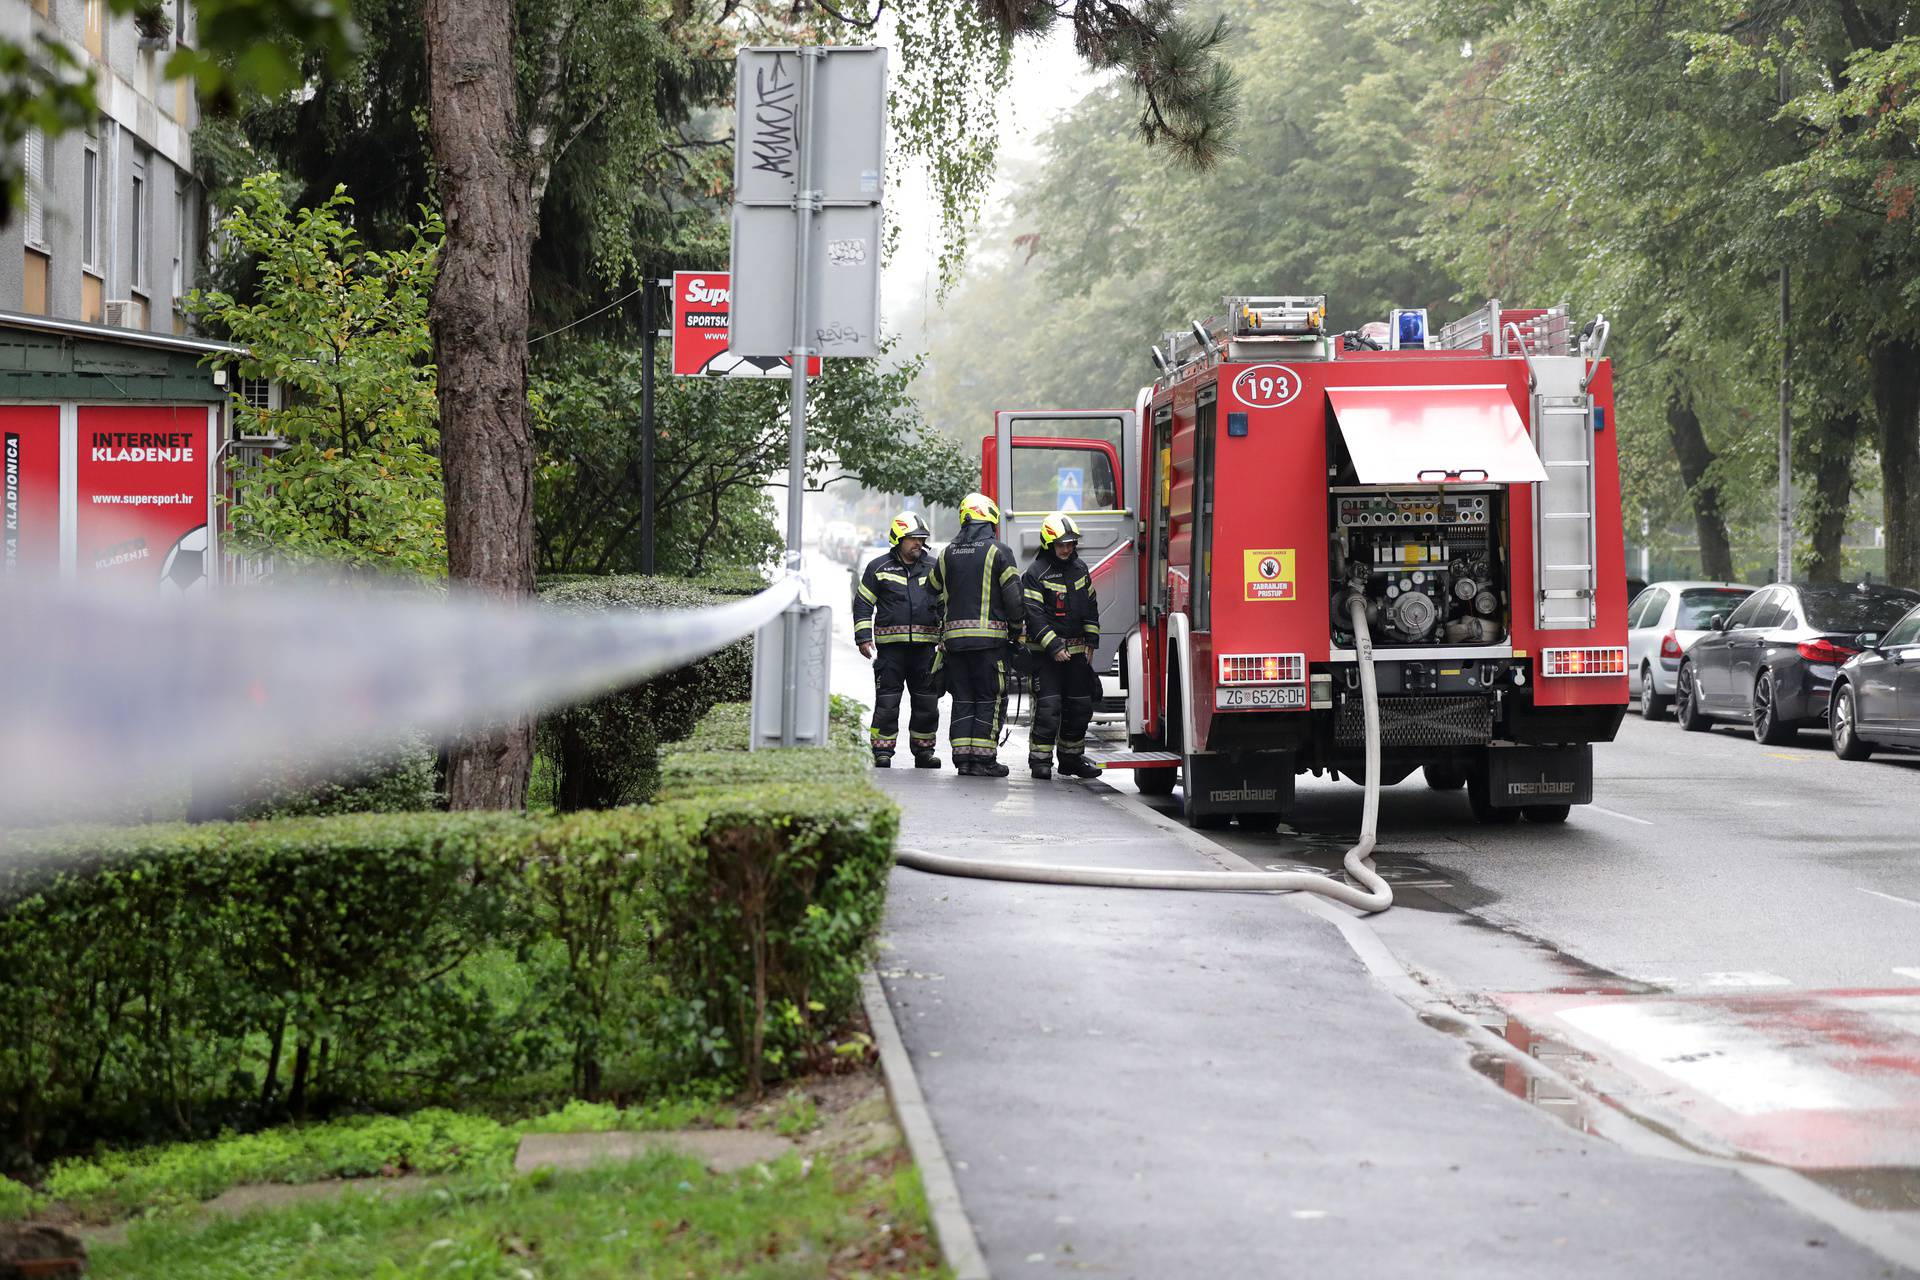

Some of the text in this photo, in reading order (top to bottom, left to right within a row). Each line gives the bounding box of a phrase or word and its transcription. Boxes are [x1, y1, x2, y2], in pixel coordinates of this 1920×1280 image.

[1248, 376, 1289, 400] 193
[93, 432, 193, 448] INTERNET
[92, 447, 193, 462] KLAĐENJE
[7, 438, 18, 530] KLADIONICA
[92, 493, 193, 506] www.supersport.hr
[1226, 690, 1243, 704] ZG
[1210, 780, 1277, 802] rosenbauer
[1507, 772, 1575, 794] rosenbauer
